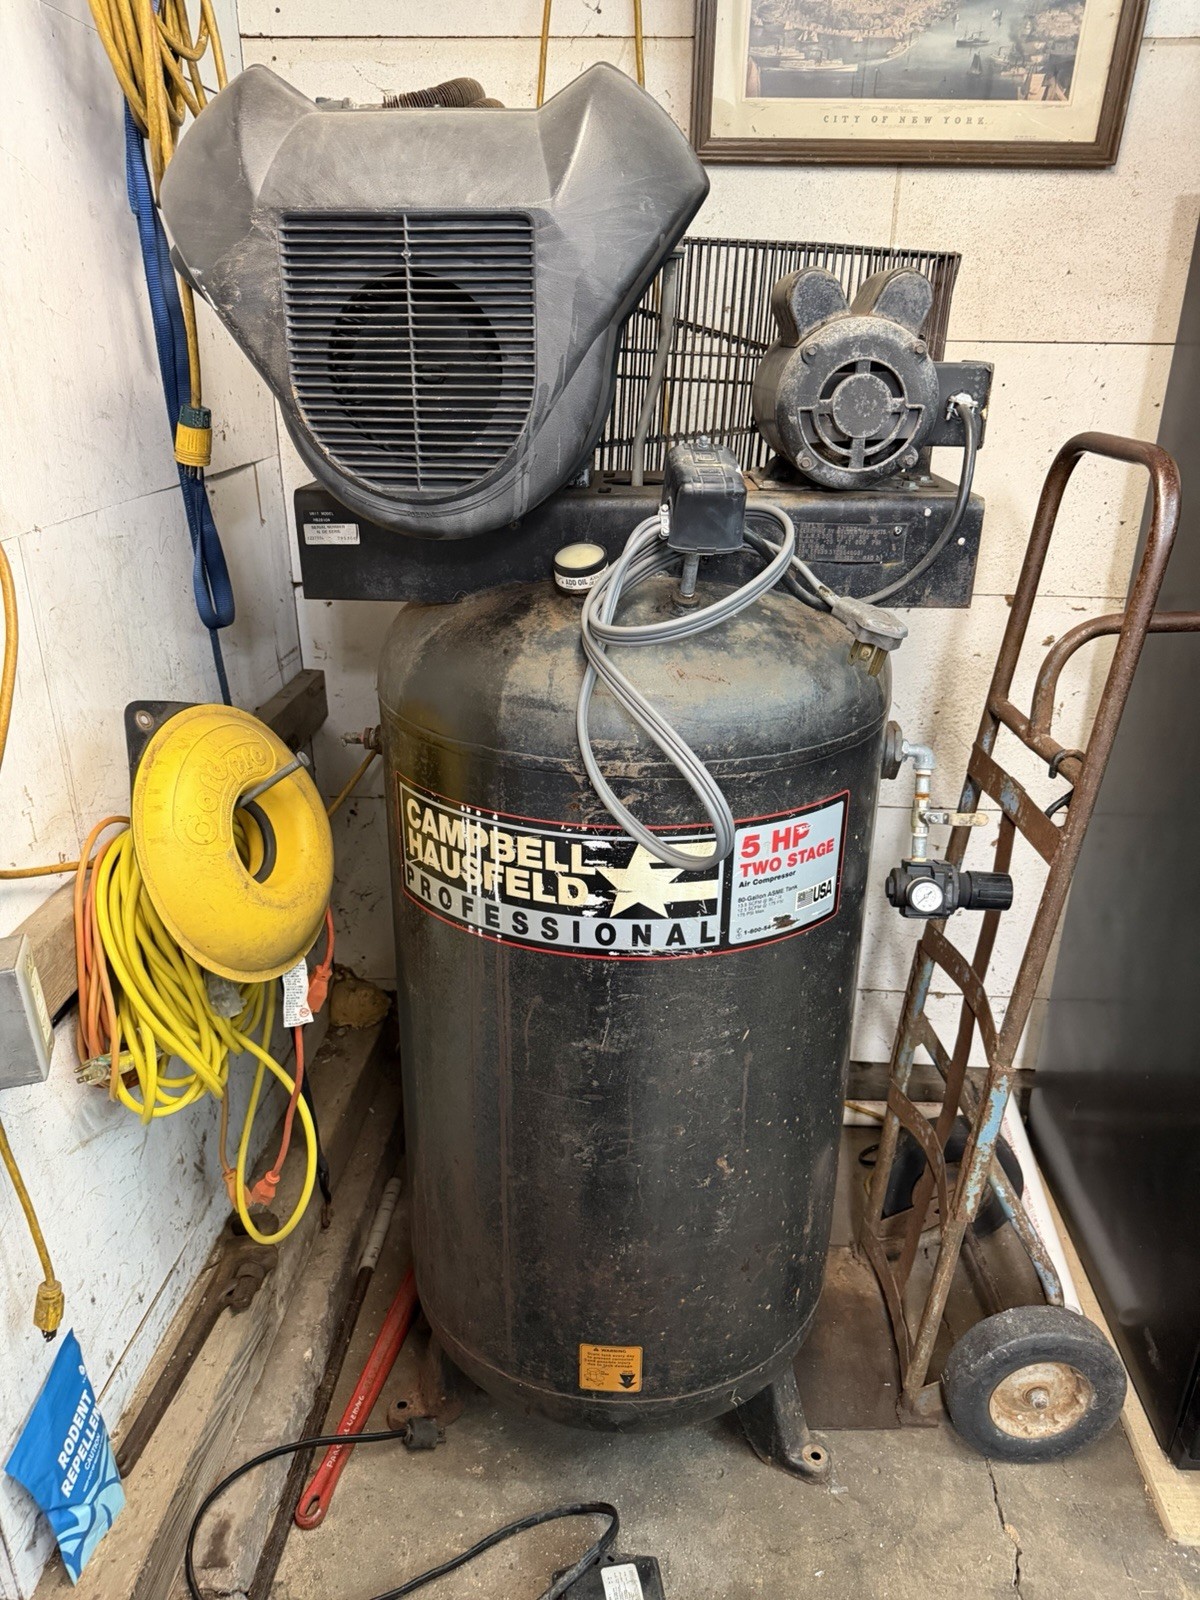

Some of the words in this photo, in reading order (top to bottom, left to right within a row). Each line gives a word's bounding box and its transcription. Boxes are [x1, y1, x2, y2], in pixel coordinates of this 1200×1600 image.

[823, 114, 861, 124] CITY
[870, 115, 889, 124] OF
[898, 115, 933, 125] NEW
[565, 578, 577, 586] ADD
[577, 578, 588, 586] OIL
[406, 798, 596, 876] CAMPBELL
[741, 833, 760, 859] 5
[771, 822, 810, 854] HP
[407, 827, 589, 908] HAUSFELD
[740, 857, 782, 878] TWO
[786, 837, 835, 868] STAGE
[737, 892, 767, 904] 80-Gallon
[767, 888, 785, 897] ASME
[785, 884, 798, 893] Tank
[738, 880, 751, 889] Air
[752, 870, 796, 886] Compressor
[812, 879, 833, 903] USA
[405, 866, 716, 947] PROFESSIONAL
[57, 1388, 92, 1470] RODENT
[84, 1432, 101, 1471] CAUTION
